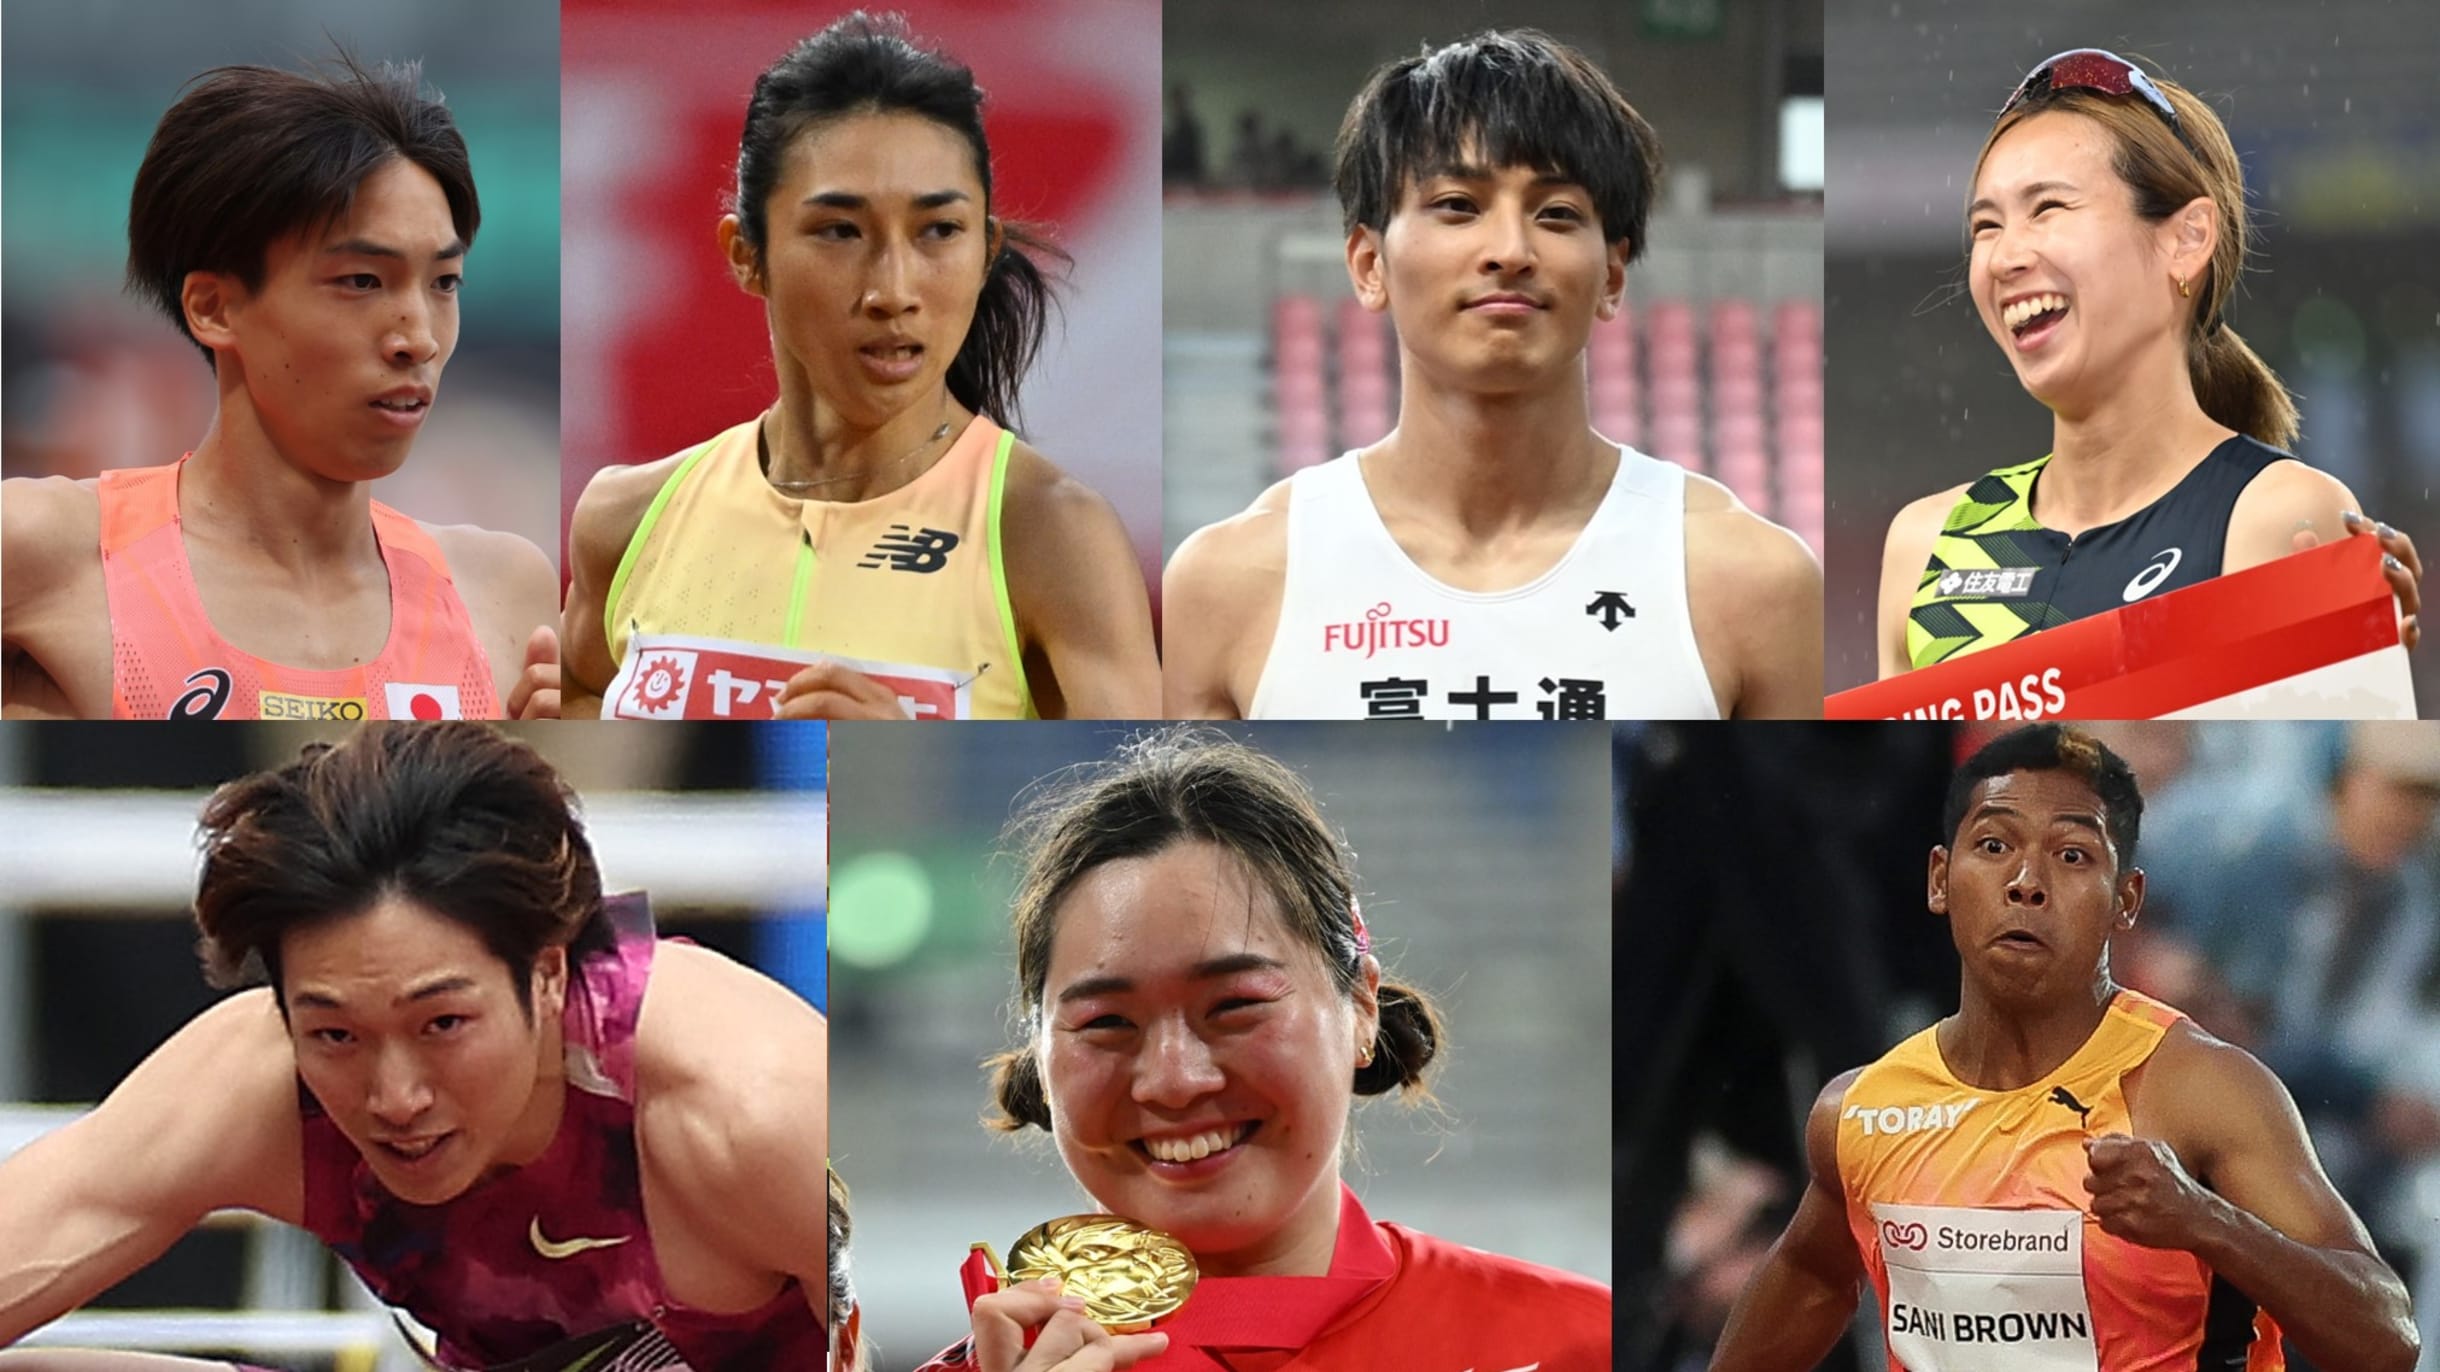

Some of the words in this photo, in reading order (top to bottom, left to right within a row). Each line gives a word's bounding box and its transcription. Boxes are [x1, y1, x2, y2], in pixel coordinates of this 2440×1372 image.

[1962, 571, 2031, 594] 住友電工
[1324, 602, 1449, 659] FUJITSU
[264, 695, 363, 720] SEIKO
[1360, 676, 1606, 720] 富士通
[1973, 667, 2066, 720] PASS
[1937, 1226, 2069, 1251] Storebrand
[1892, 1304, 1946, 1341] SANI
[1953, 1312, 2087, 1343] BROWN
